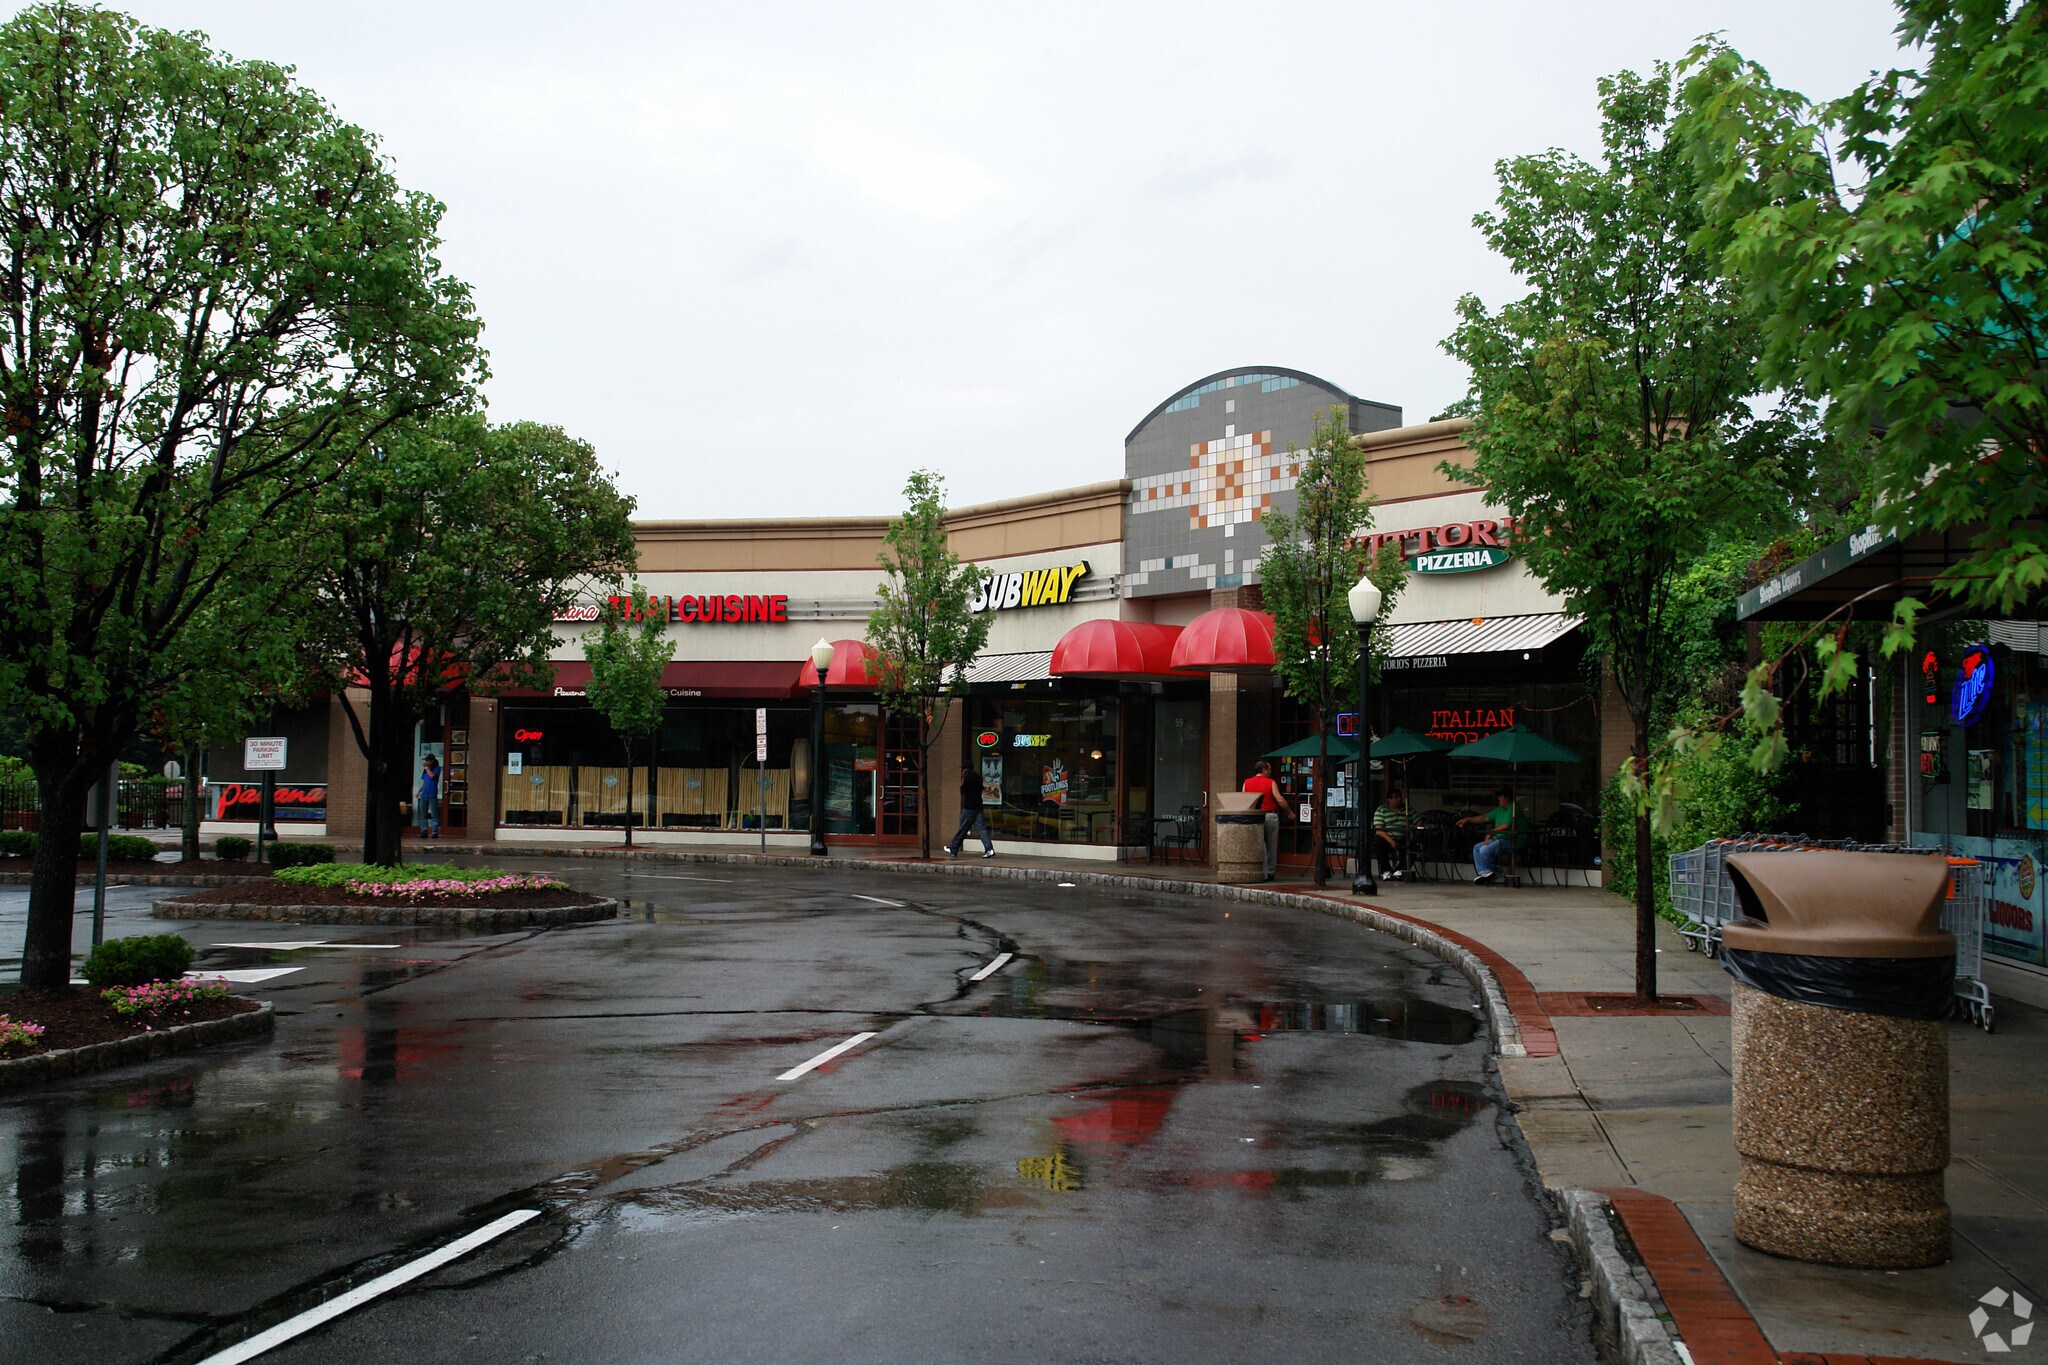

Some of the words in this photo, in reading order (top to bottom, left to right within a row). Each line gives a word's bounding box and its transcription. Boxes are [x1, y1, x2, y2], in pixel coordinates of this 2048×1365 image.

[1417, 550, 1492, 571] PIZZERIA
[969, 561, 1088, 612] SUBWAY
[1759, 578, 1782, 604] ShopRite
[1781, 570, 1801, 593] Liquors
[677, 595, 787, 622] CUISINE
[1413, 656, 1447, 669] PIZZERIA
[554, 686, 586, 697] Pawana
[670, 688, 702, 697] Cuisine
[1432, 709, 1515, 728] ITALIAN
[514, 729, 543, 743] Open
[980, 734, 996, 745] OPEN
[1013, 734, 1051, 747] SUBWAY
[217, 784, 328, 819] Paana
[1988, 898, 2033, 932] LIQUORS
